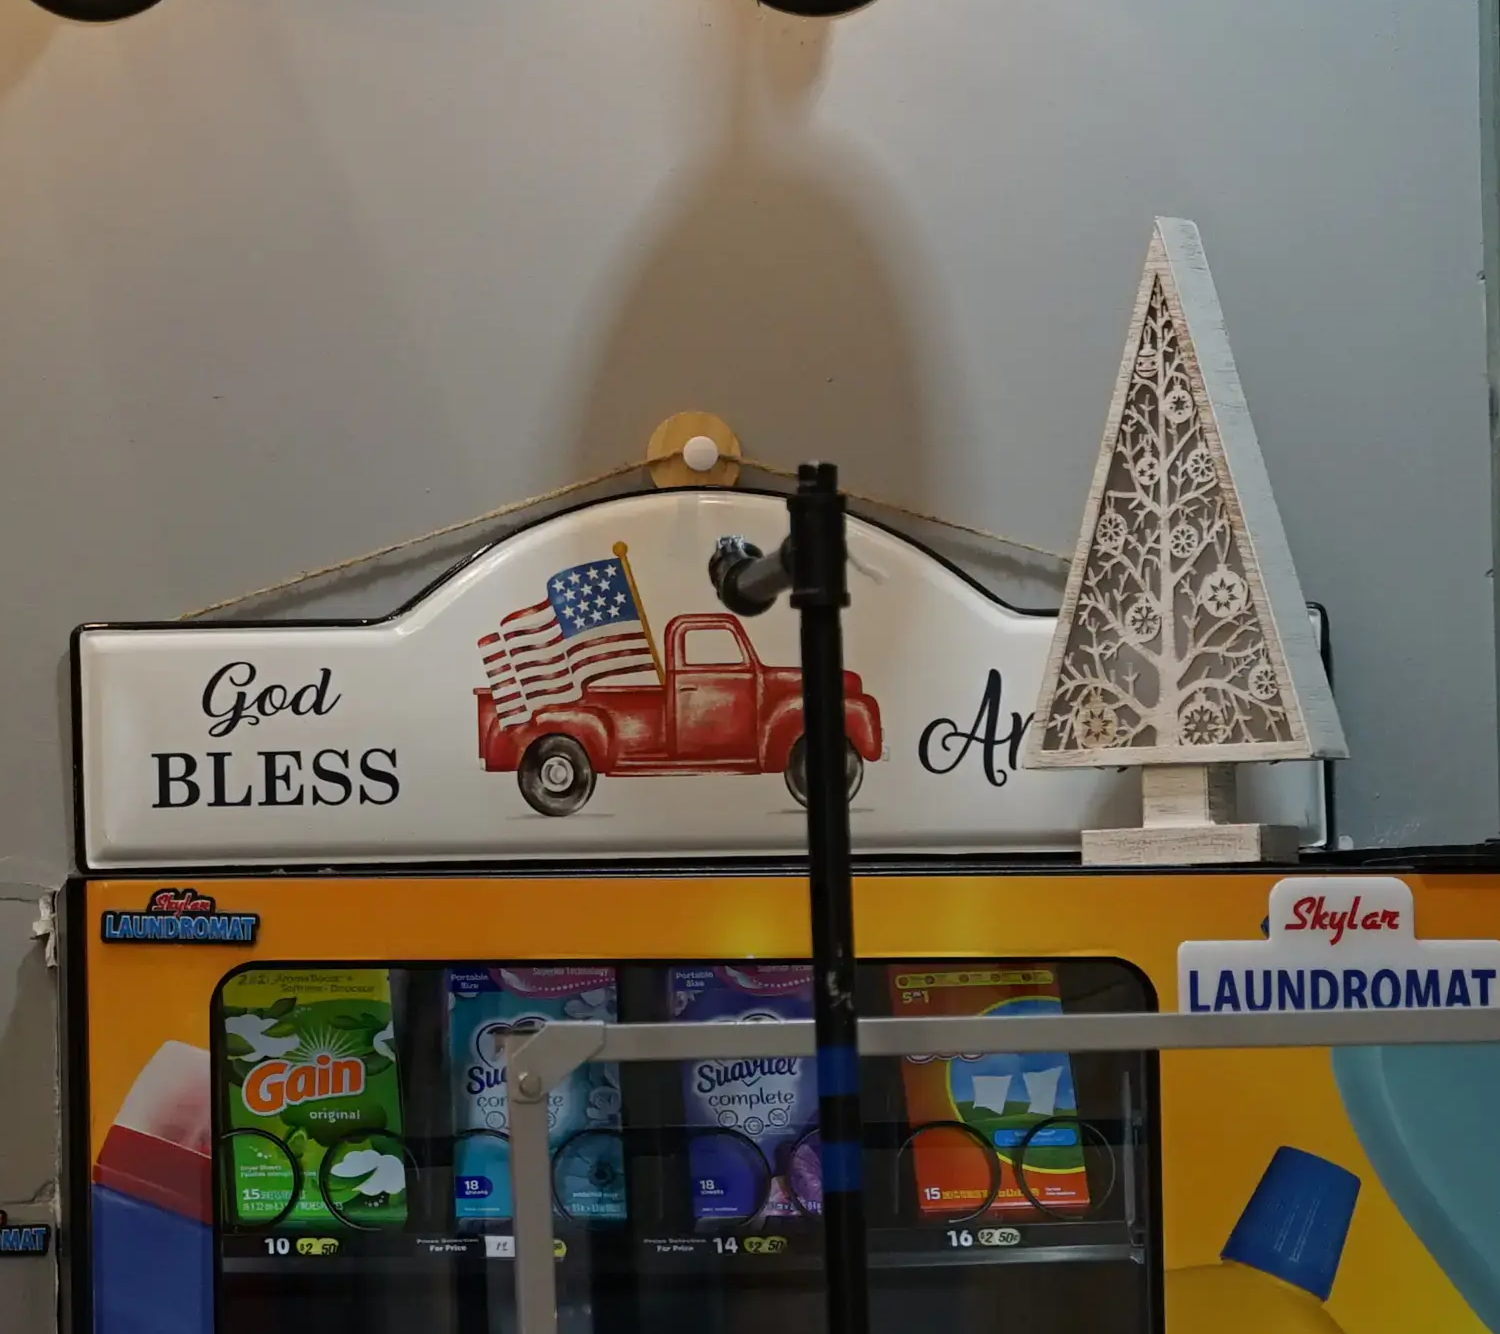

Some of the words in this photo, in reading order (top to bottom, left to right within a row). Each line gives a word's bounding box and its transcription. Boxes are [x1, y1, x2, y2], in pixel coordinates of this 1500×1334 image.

[201, 660, 343, 738] God
[151, 747, 401, 809] BLESS
[105, 915, 256, 942] LAUNDROMAT
[1285, 896, 1399, 945] Skylar
[1188, 968, 1497, 1013] LAUNDROMAT
[242, 1055, 364, 1114] Gain
[708, 1091, 795, 1112] complete
[309, 1108, 361, 1124] original
[264, 1238, 290, 1256] 10
[713, 1238, 739, 1254] 14
[947, 1231, 974, 1247] 16
